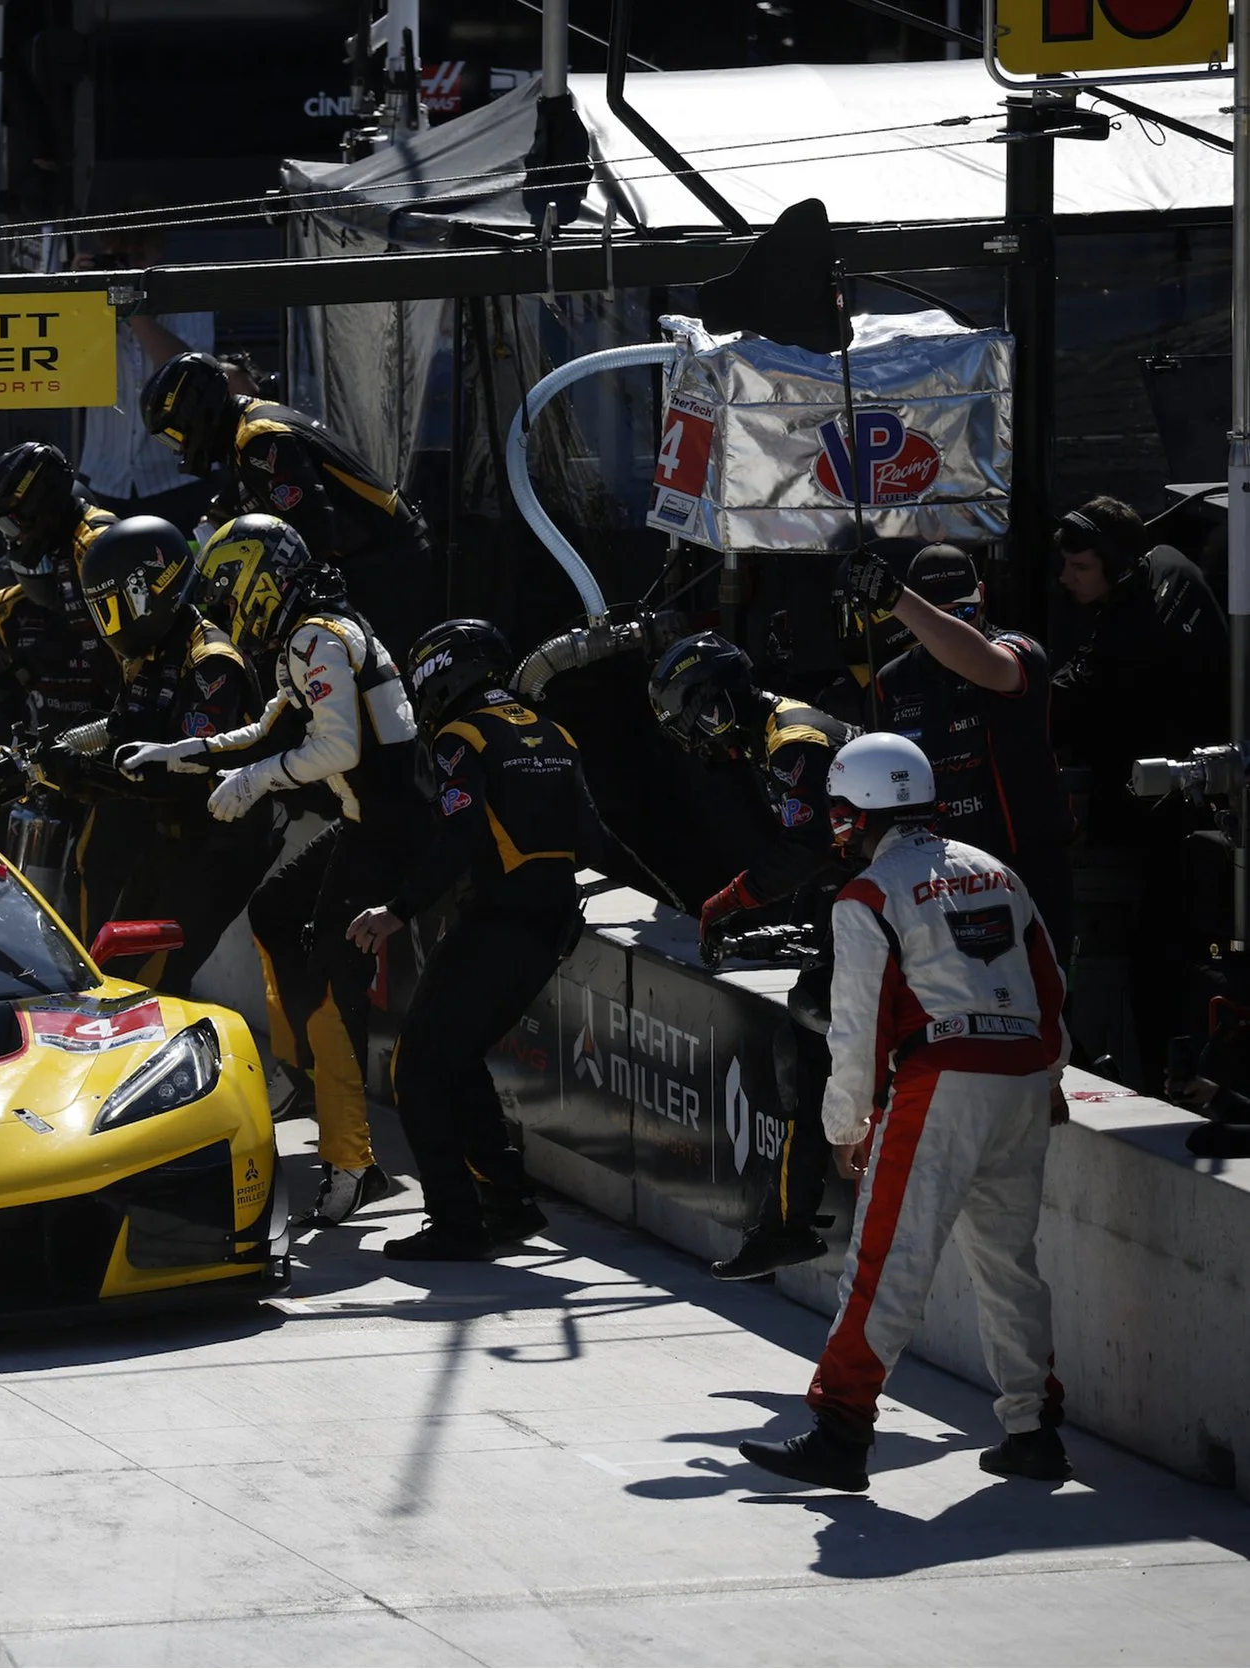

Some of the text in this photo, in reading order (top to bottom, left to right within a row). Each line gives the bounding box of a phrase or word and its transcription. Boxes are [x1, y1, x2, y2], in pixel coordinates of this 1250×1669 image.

[671, 394, 714, 418] herTech
[658, 419, 684, 481] 4
[817, 410, 905, 505] VP
[877, 455, 940, 492] Racing
[503, 757, 573, 769] PRATT MILLER
[913, 872, 1015, 905] OFFICIAL
[75, 1018, 120, 1038] 4
[609, 1000, 699, 1076] PRATT
[609, 1053, 699, 1132] MILLER
[237, 1181, 265, 1196] PRATT
[237, 1190, 266, 1205] MILLER
